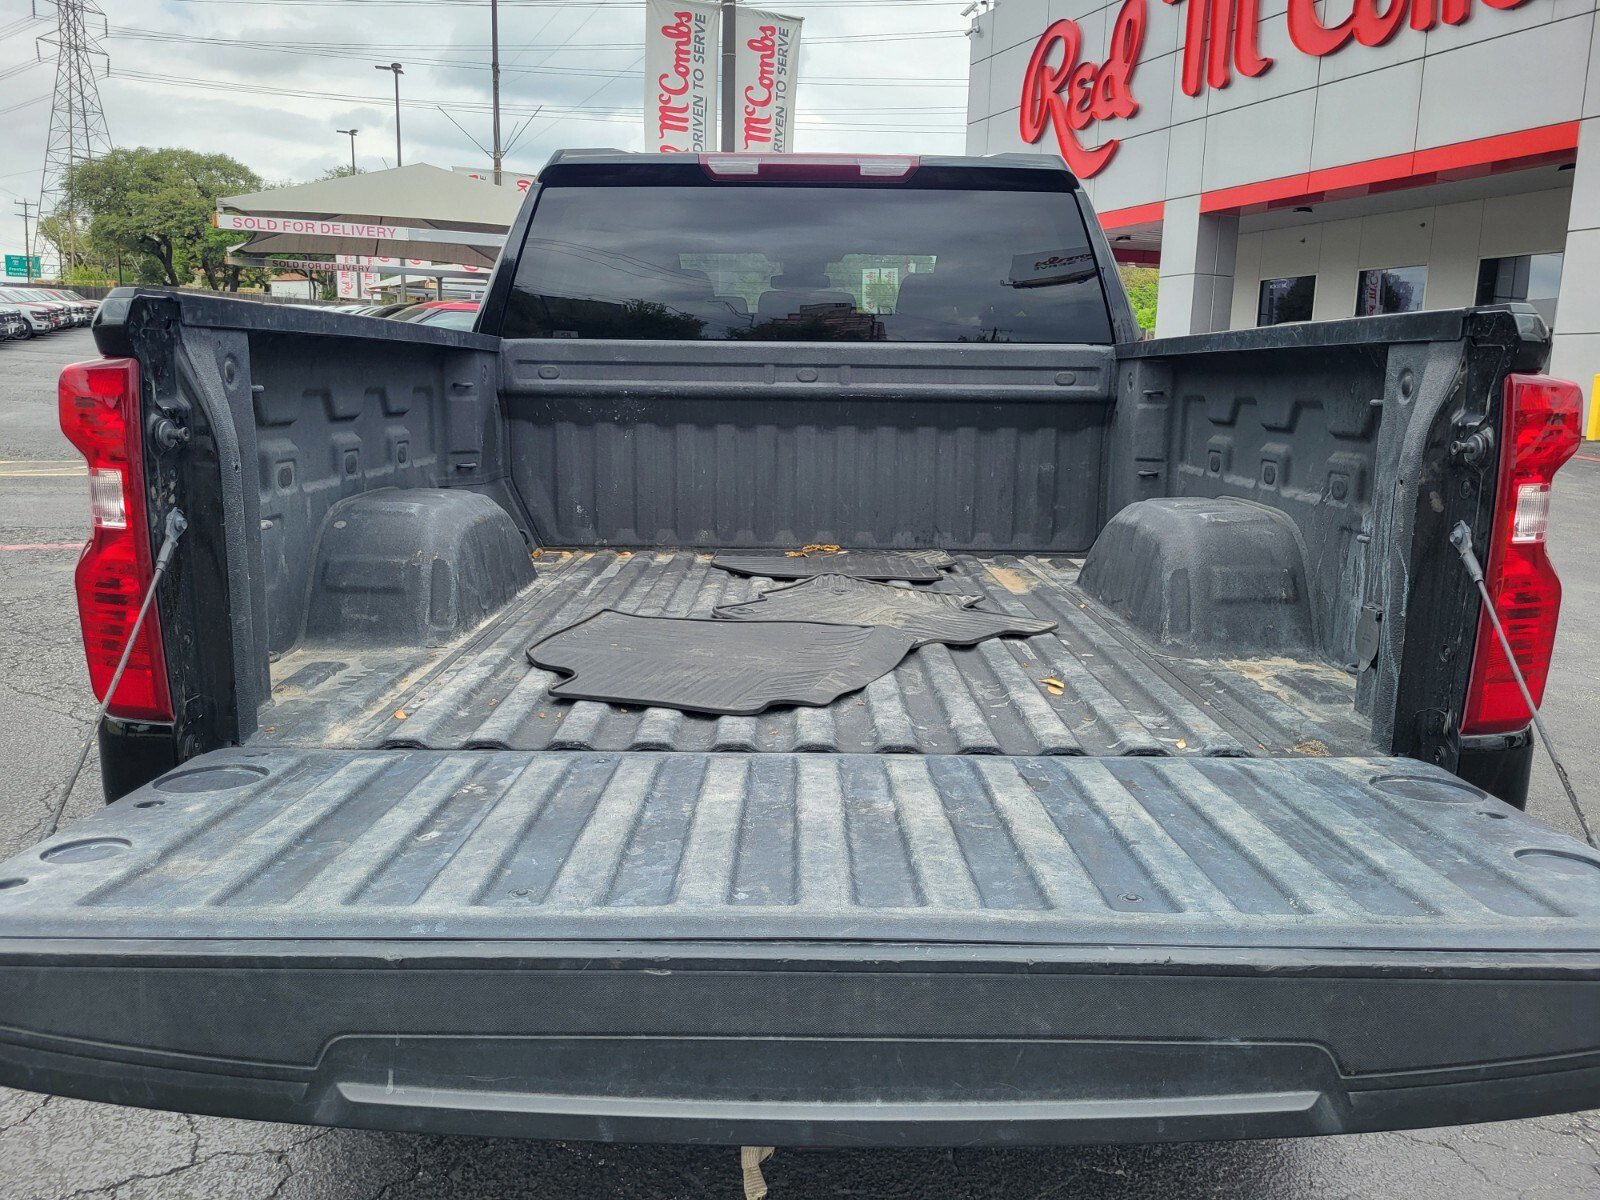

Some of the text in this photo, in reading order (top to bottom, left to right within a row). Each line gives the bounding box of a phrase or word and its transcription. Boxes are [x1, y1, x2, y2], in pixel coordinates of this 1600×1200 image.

[659, 11, 692, 139] McCombs
[693, 68, 704, 89] TO
[694, 13, 706, 64] SERVE
[744, 25, 776, 150] McCombs
[773, 26, 789, 153] RIVEN TO SERVE
[1020, 0, 1146, 178] Red
[232, 217, 397, 239] SOLD FOR DELIVERY
[272, 259, 299, 269] SOLD
[301, 261, 322, 271] FOR
[324, 262, 371, 273] DELIVERY
